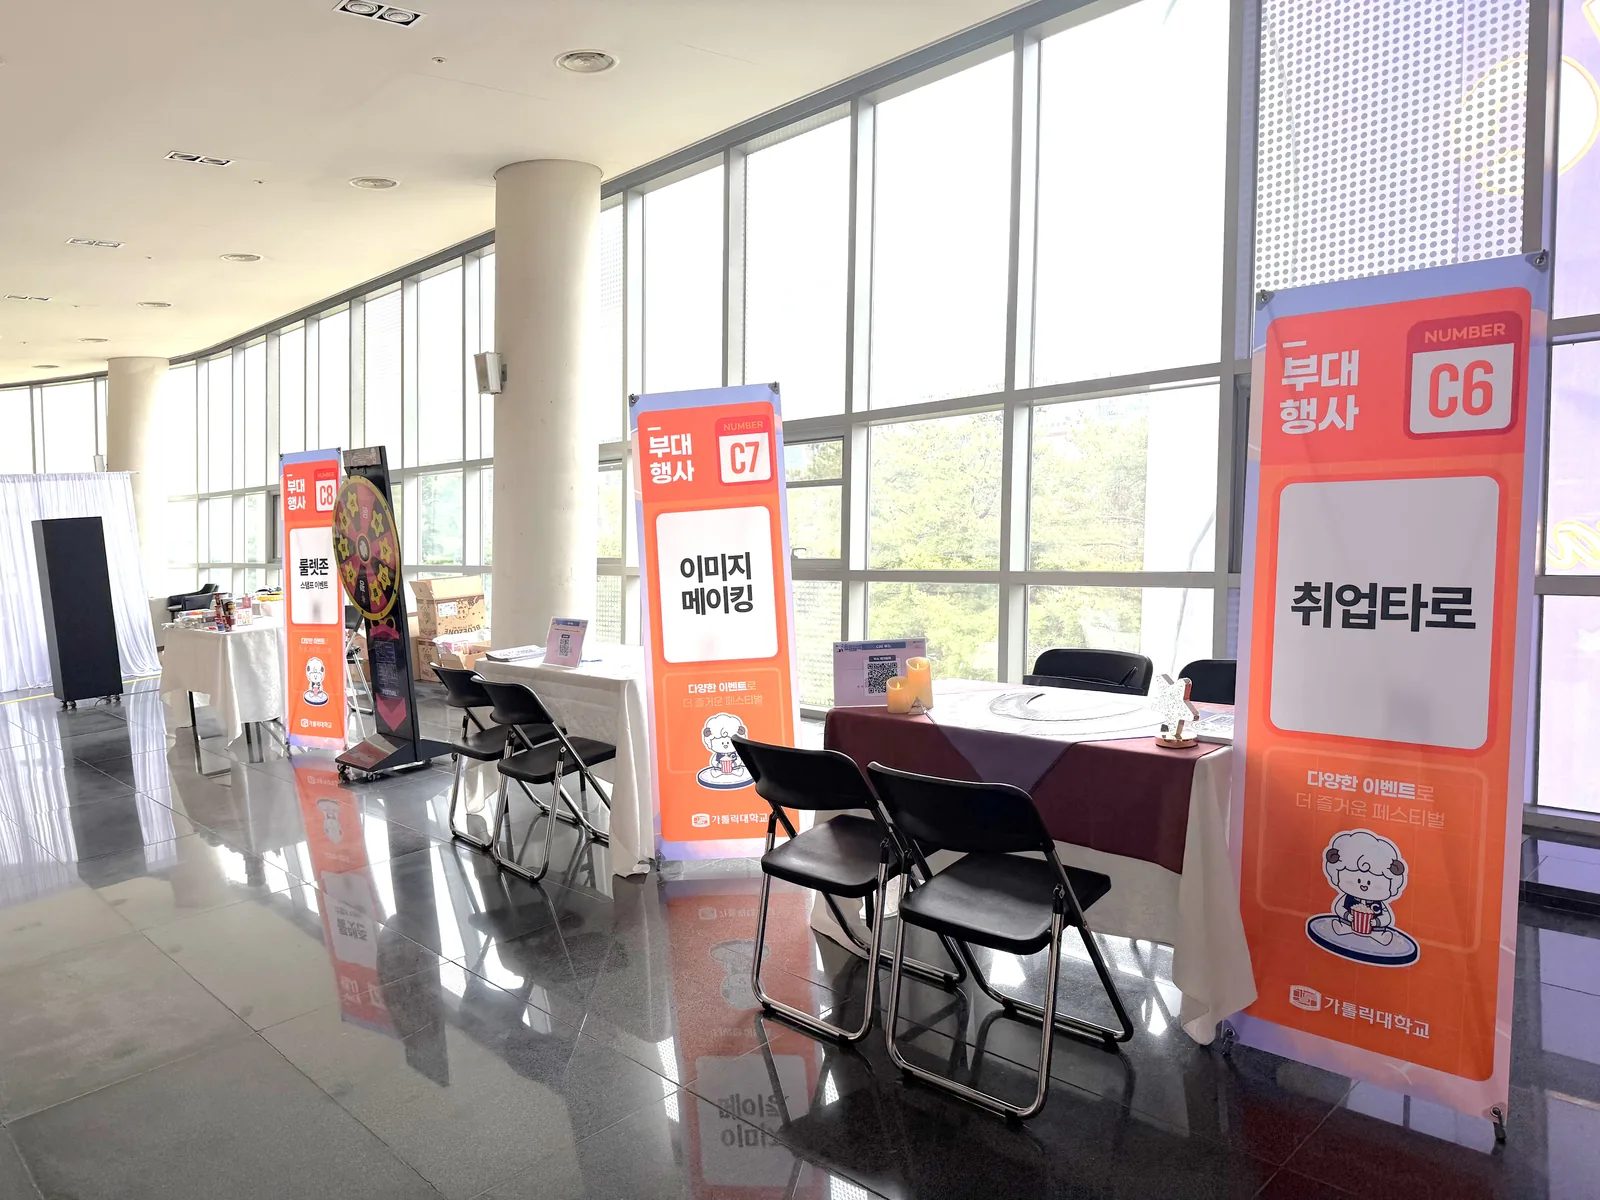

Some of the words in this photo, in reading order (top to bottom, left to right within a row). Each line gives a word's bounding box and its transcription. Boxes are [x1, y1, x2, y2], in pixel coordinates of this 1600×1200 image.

[1424, 322, 1506, 344] NUMBER
[1281, 349, 1359, 392] 부대
[1429, 360, 1494, 419] C6
[723, 420, 763, 431] NUMBER
[1279, 394, 1359, 435] 행사
[649, 433, 693, 457] 부대
[730, 441, 760, 475] C7
[650, 460, 694, 484] 행사
[287, 479, 306, 494] 부대
[319, 485, 334, 506] C8
[287, 496, 306, 510] 행사
[299, 558, 329, 576] 룰렛존
[680, 551, 751, 583] 이미지
[315, 581, 329, 590] 이벤트
[682, 584, 754, 615] 메이킹
[1290, 581, 1477, 632] 취업타로
[688, 683, 716, 694] 다양한
[719, 681, 756, 692] 이벤트로
[725, 694, 763, 708] 페스티벌
[1306, 769, 1358, 792] 다양한
[1363, 777, 1434, 801] 이벤트로
[711, 812, 769, 825] 가톨릭대학교
[1296, 792, 1311, 810] 더
[1316, 795, 1367, 818] 즐거운
[1372, 802, 1446, 829] 페스티벌
[1324, 997, 1431, 1040] 가톨릭대학교
